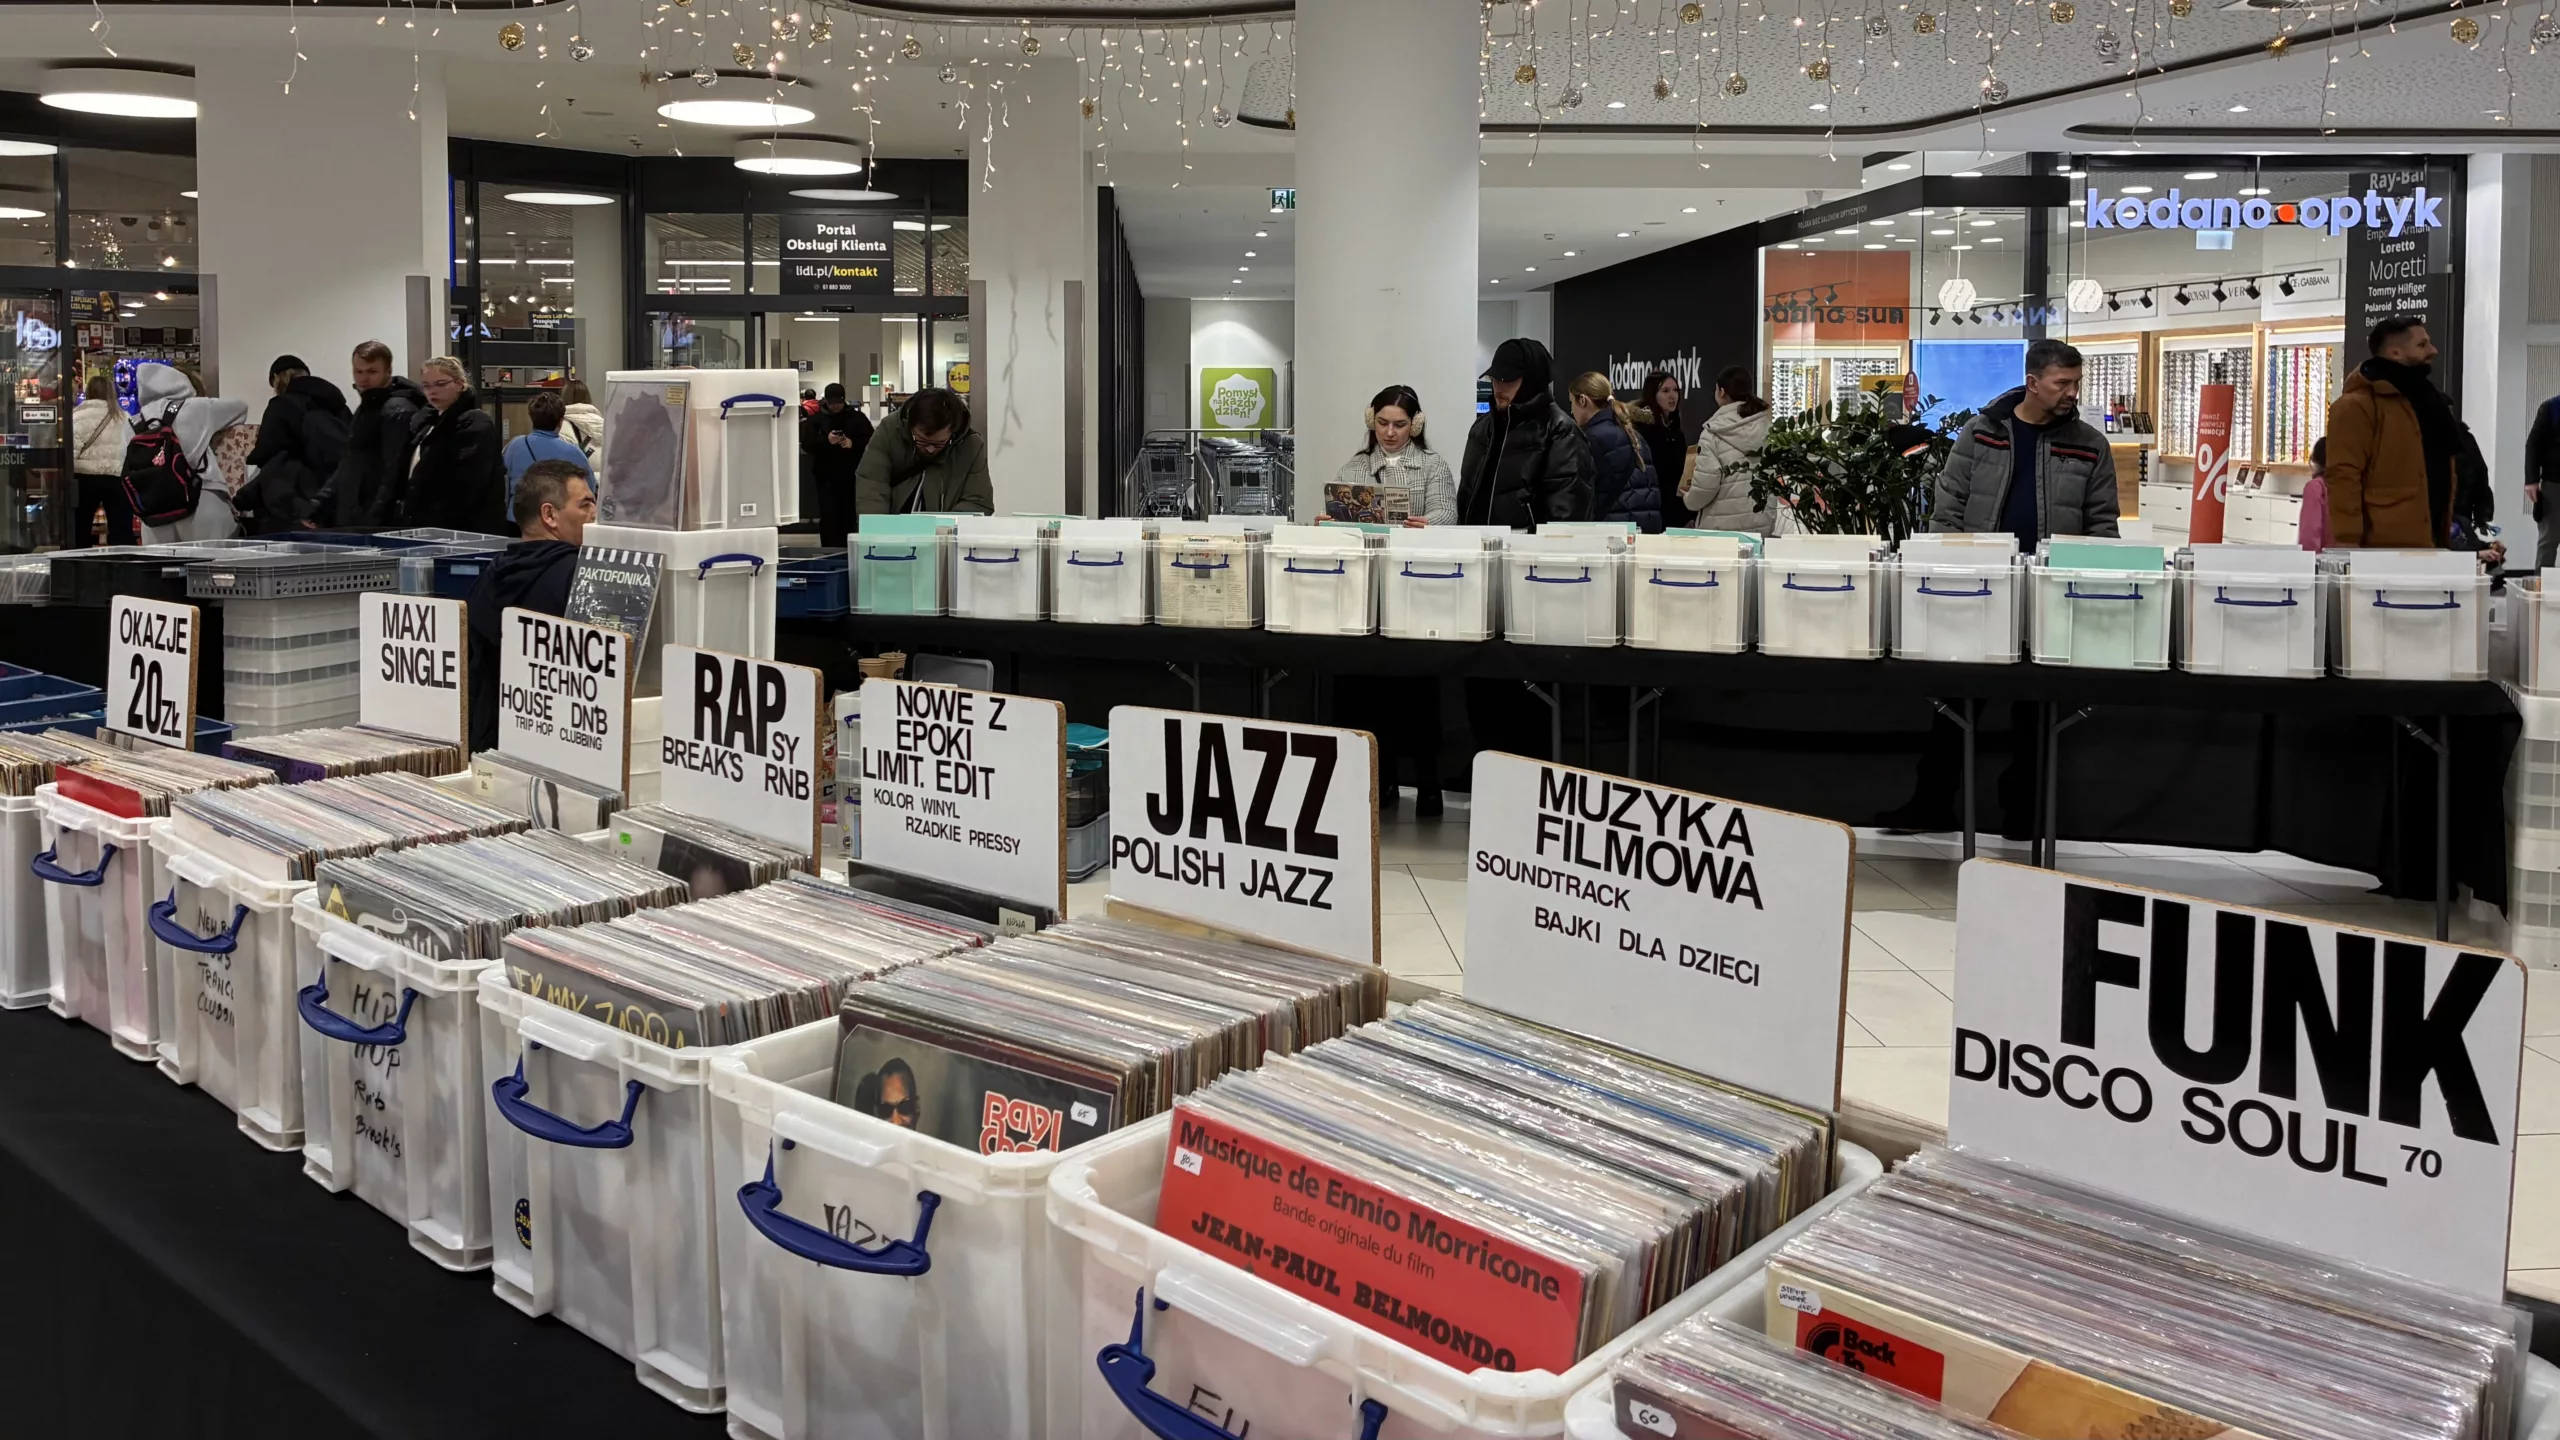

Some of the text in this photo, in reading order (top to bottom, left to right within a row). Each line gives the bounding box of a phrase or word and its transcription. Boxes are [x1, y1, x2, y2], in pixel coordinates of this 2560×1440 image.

[817, 224, 856, 235] Portal
[2087, 188, 2272, 229] kodano
[2300, 187, 2443, 237] optyk
[787, 239, 887, 253] Obsługi Klienta
[2381, 241, 2415, 255] Loretto
[796, 265, 878, 278] lidl.pl/kontakt
[2370, 253, 2426, 281] Moretti
[2365, 298, 2428, 312] Polaroid Solano
[2368, 282, 2426, 298] Tommy Hilfiger
[1856, 305, 1904, 324] sun
[1215, 405, 1251, 418] dzień!
[1218, 388, 1258, 400] Pomysł
[1223, 397, 1257, 410] każdy
[577, 566, 651, 587] PAKTOFONIKA
[120, 608, 188, 655] OKAZJE
[382, 602, 436, 643] MAXI
[381, 643, 457, 689] SINGLE
[518, 615, 616, 678] TRANCE
[501, 683, 553, 721] HOUSE
[528, 662, 598, 702] TECHNO
[896, 685, 1007, 731] NOWE Z
[515, 715, 602, 751] TRIP HOP CLUBBING
[896, 719, 972, 761] EPOKI
[765, 762, 810, 800] RNB
[862, 747, 996, 800] LIMIT. EDIT
[1146, 718, 1339, 860] JAZZ
[873, 788, 961, 819] KOLOR WINYL
[1538, 766, 1755, 857] MUZYKA
[905, 816, 1021, 856] RZADKIE PRESSY
[1111, 834, 1334, 910] POLISH JAZZ
[1475, 850, 1632, 913] SOUNDTRACK
[1536, 812, 1764, 911] FILMOWA
[198, 906, 218, 935] NEW
[1534, 906, 1760, 987] BAJKI DLA DZIECI
[353, 984, 397, 1022] HIP
[2060, 882, 2505, 1146] FUNK
[1954, 1027, 2443, 1188] DISCO SOUL 70
[1180, 1120, 1561, 1302] Musique de Ennio Morricone
[1272, 1196, 1436, 1282] Bande originale du film
[1191, 1211, 1516, 1373] JEAN-PAUL BELMONDO
[1844, 1327, 1896, 1367] Back
[1639, 1409, 1660, 1425] 60
